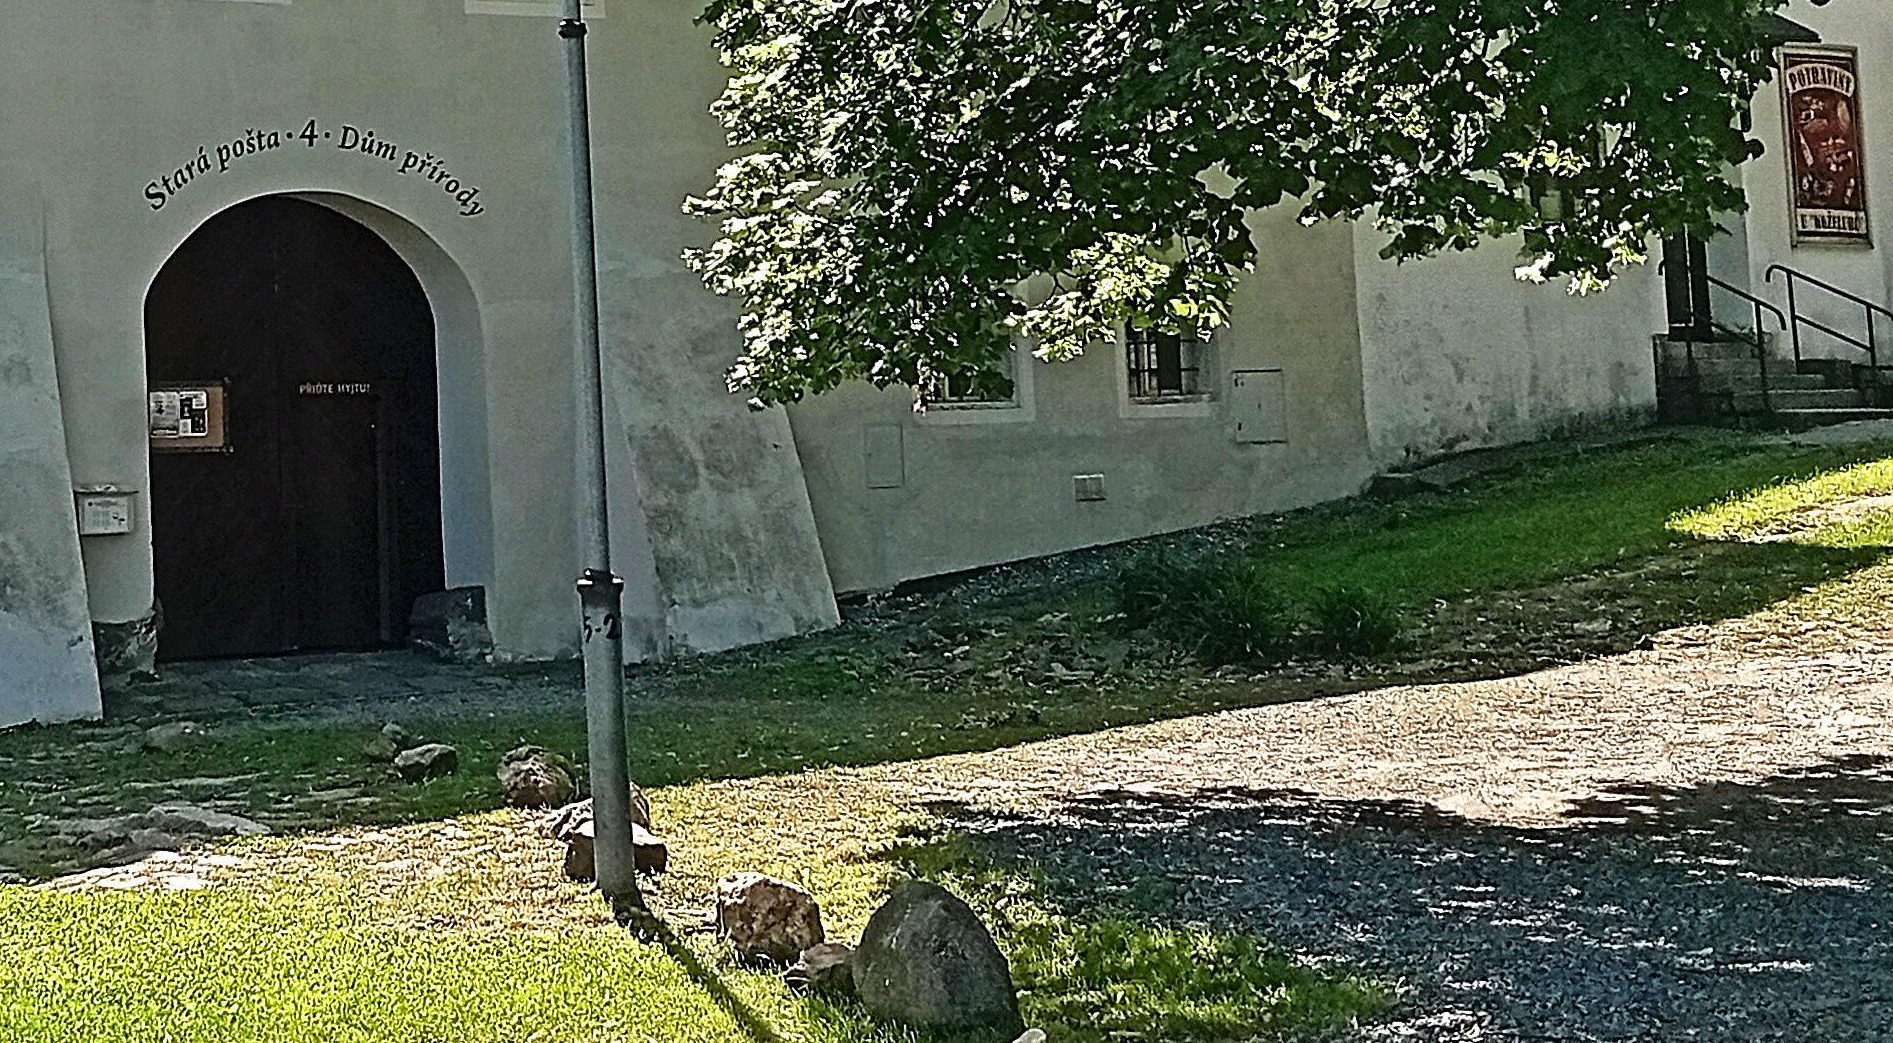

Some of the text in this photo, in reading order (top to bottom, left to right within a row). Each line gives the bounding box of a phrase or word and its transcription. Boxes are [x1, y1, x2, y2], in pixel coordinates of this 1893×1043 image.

[144, 119, 484, 216] Stará pošta 4 Dům přírody
